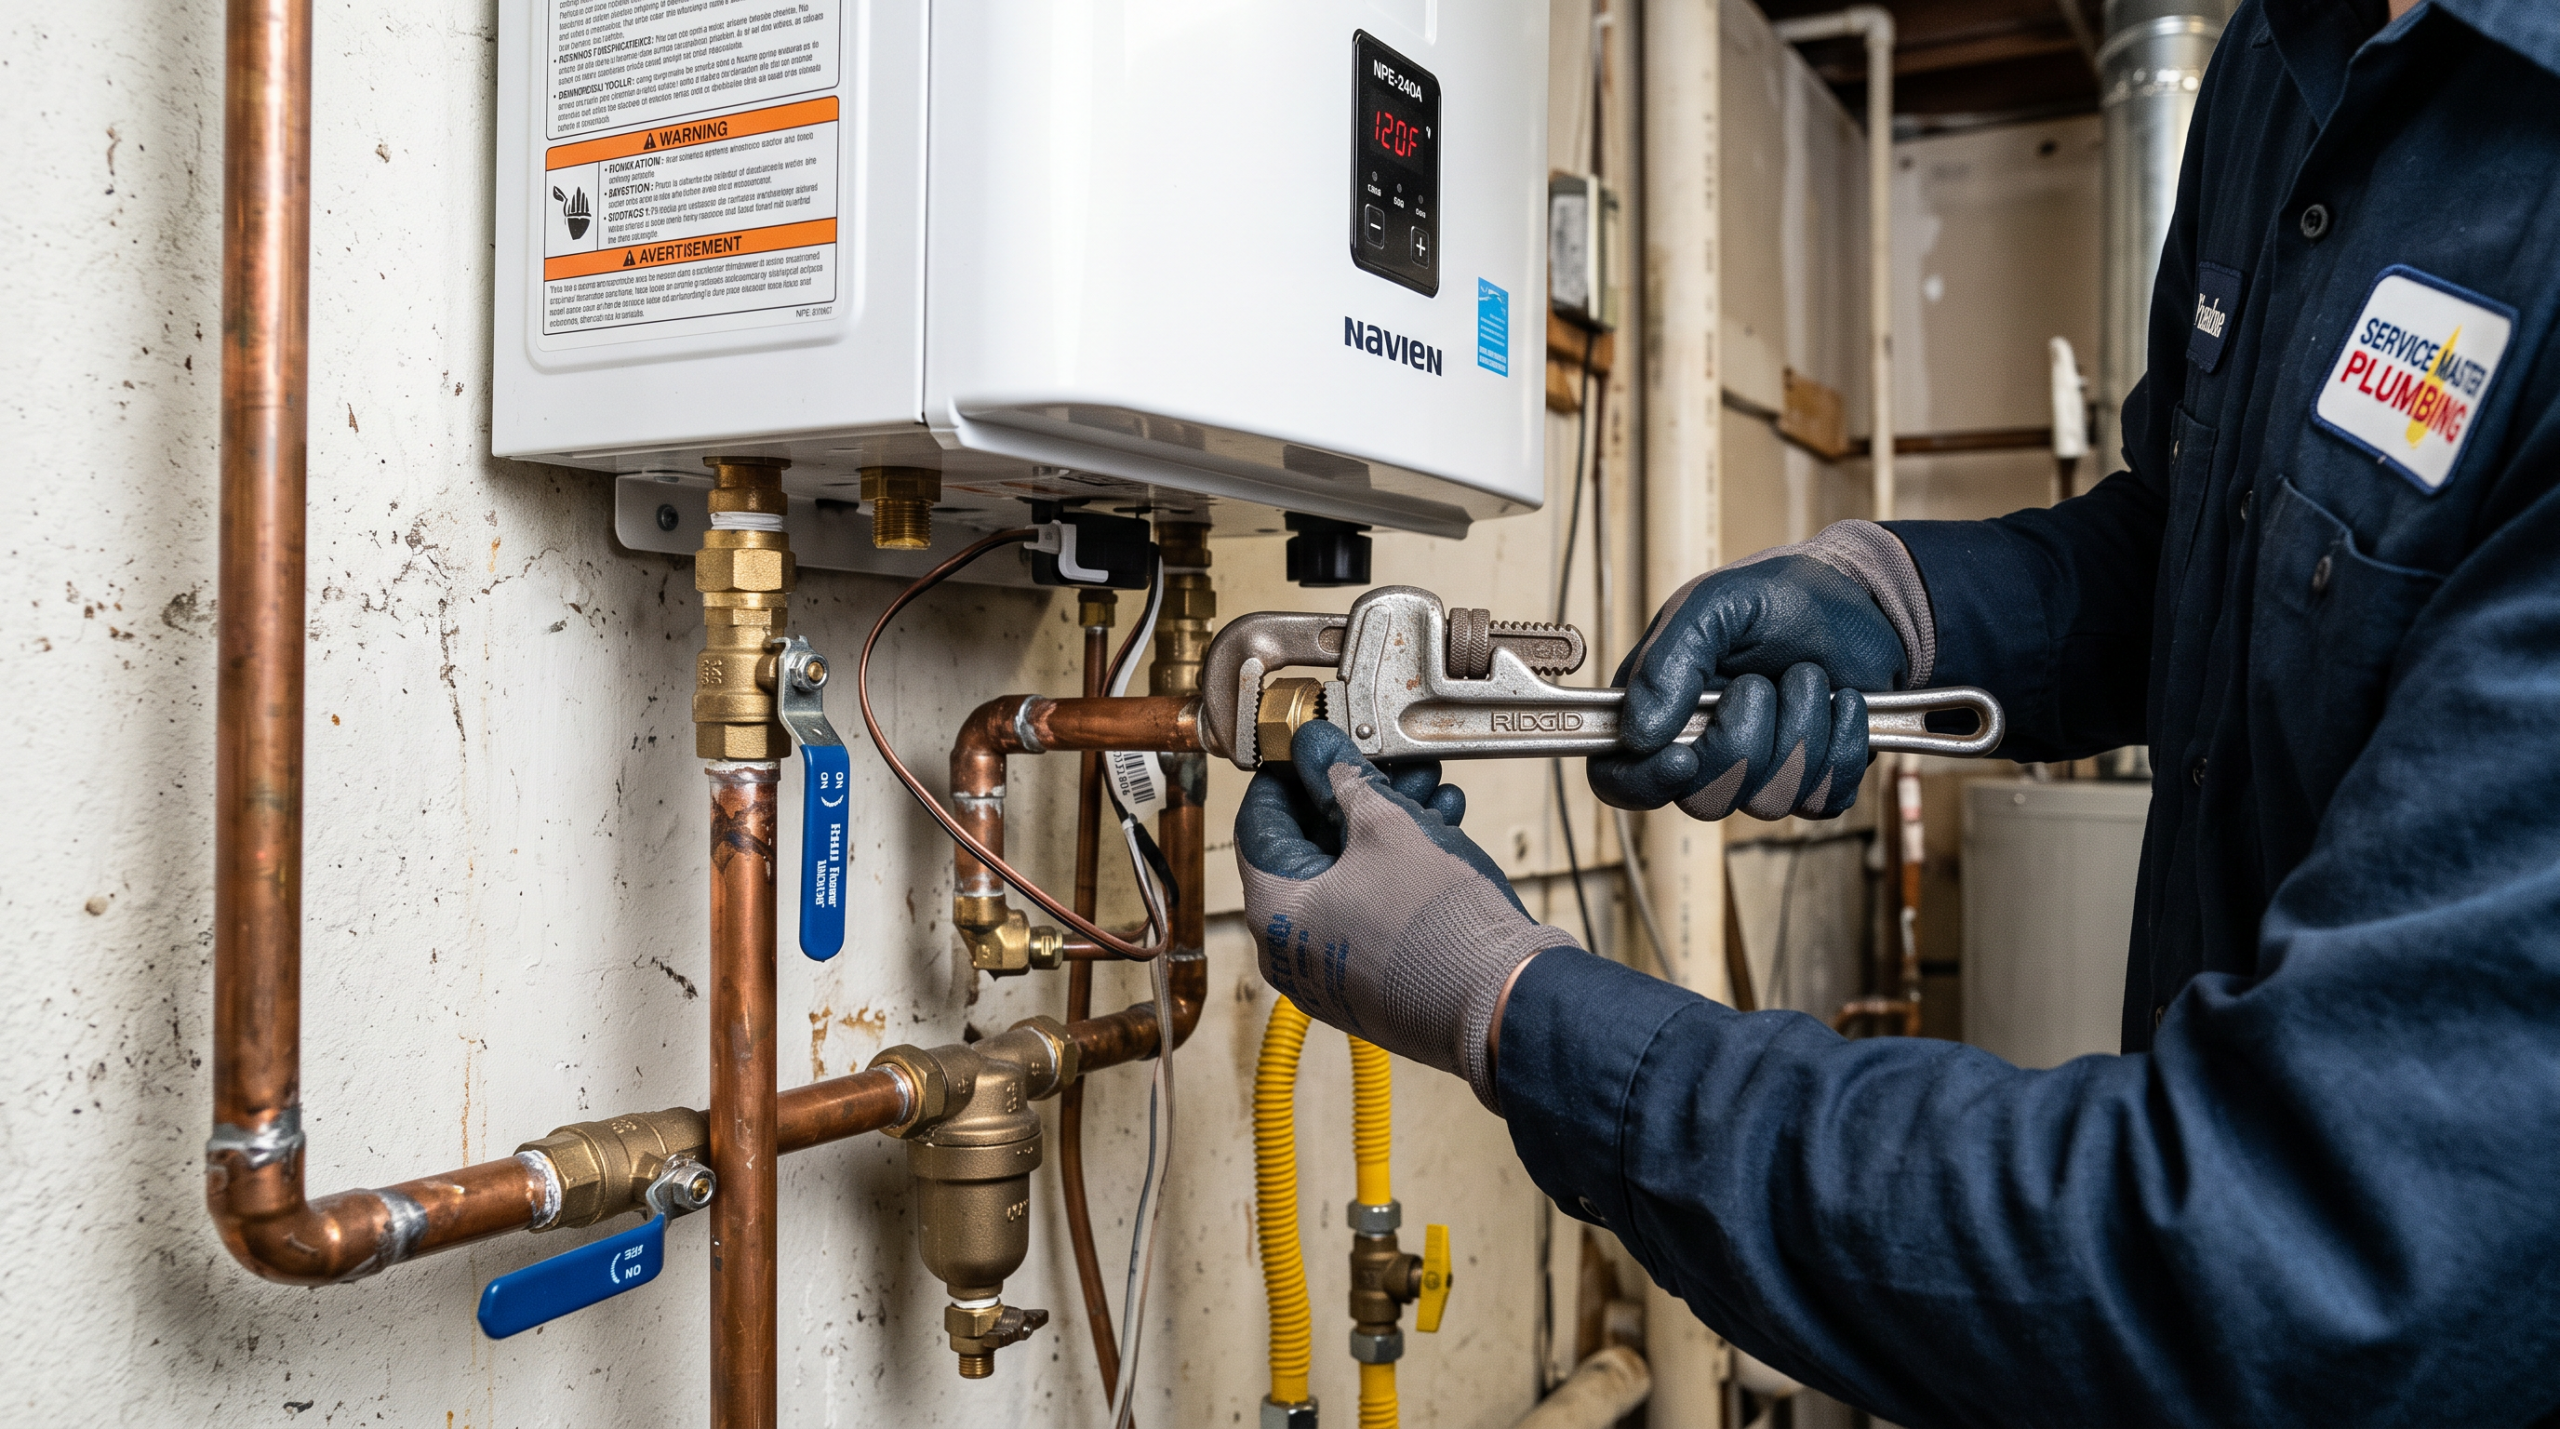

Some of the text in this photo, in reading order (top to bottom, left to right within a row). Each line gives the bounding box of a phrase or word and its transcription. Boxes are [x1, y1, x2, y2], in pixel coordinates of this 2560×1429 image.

[1373, 59, 1423, 103] NPE-240A
[659, 121, 728, 147] WARNING
[1374, 111, 1419, 158] 120F
[639, 235, 743, 264] AVERTISEMENT
[2360, 317, 2487, 398] SERVICE MASTER
[2340, 349, 2468, 445] PLUMBING
[1491, 711, 1584, 732] RIDGID
[820, 771, 829, 790] ON
[835, 771, 844, 790] ON
